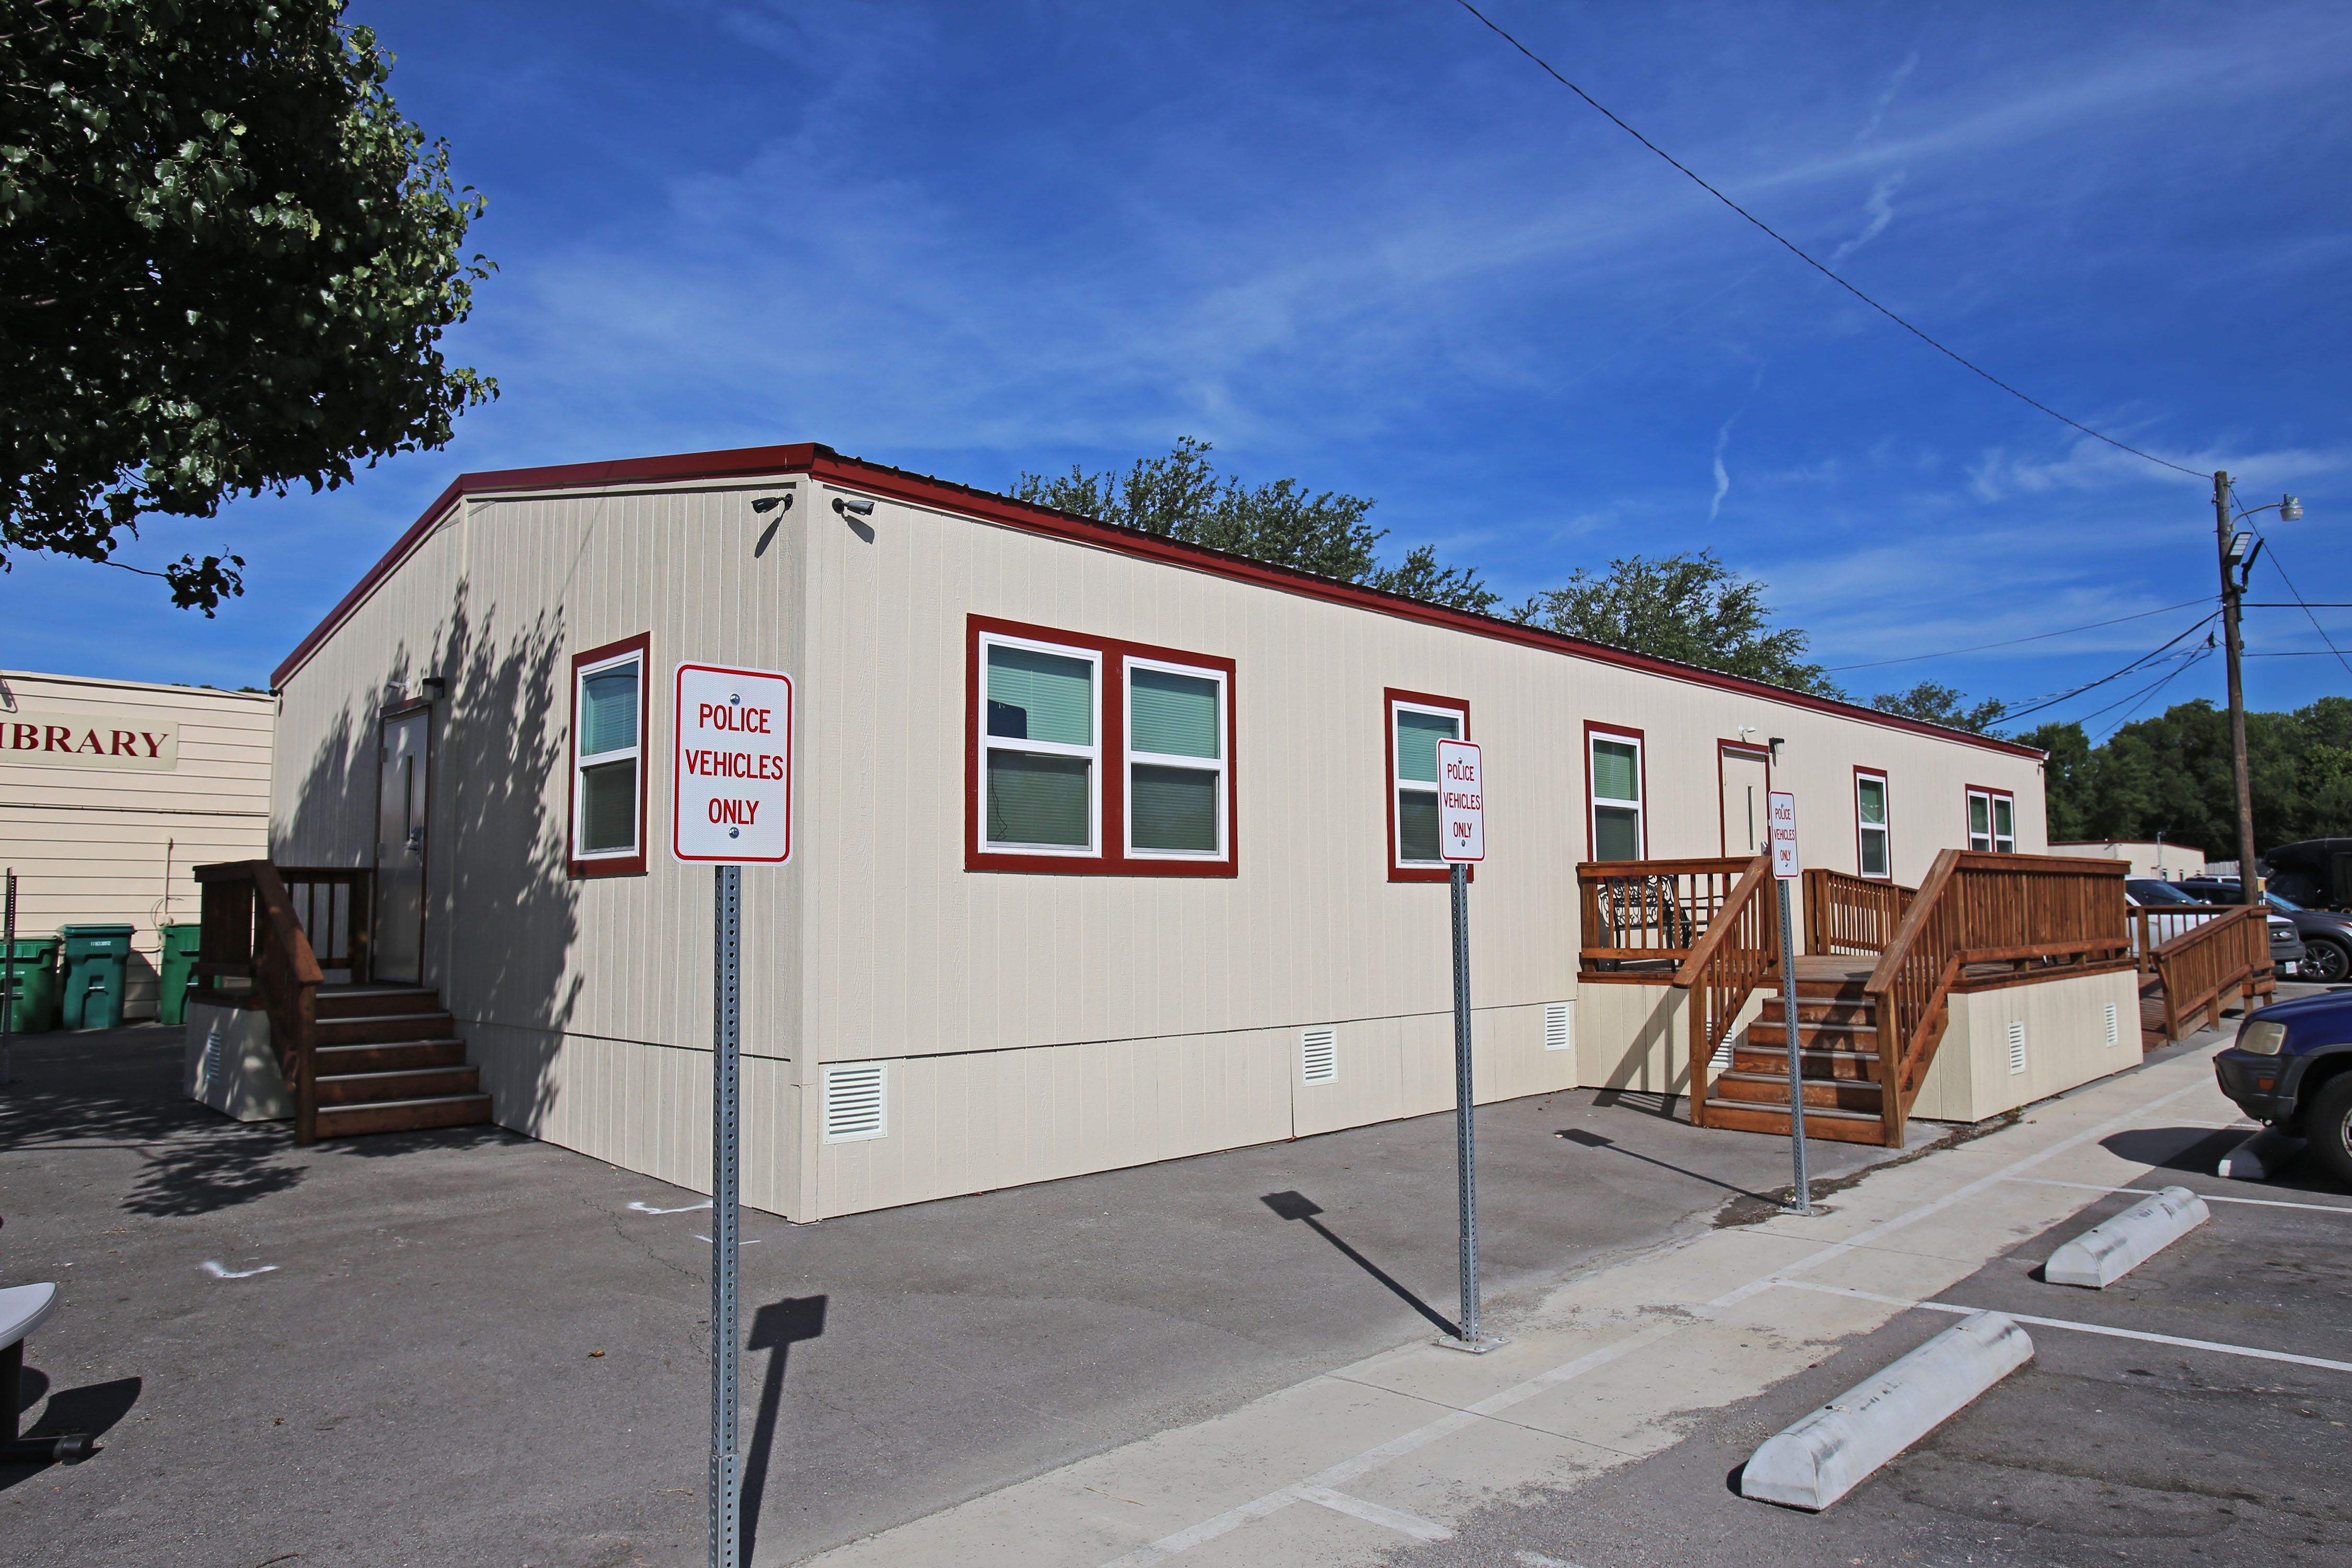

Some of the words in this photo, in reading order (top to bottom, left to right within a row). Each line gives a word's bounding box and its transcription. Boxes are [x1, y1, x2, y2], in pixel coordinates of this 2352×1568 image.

[699, 703, 771, 734] POLICE
[685, 749, 783, 780] VEHICLES
[1447, 763, 1475, 781] POLICE
[1443, 791, 1481, 810] VEHICLES
[709, 798, 759, 825] ONLY
[1775, 808, 1791, 820] POLICE
[1453, 821, 1472, 838] ONLY
[1773, 828, 1795, 841] VEHICLES
[1780, 849, 1791, 861] ONLY
